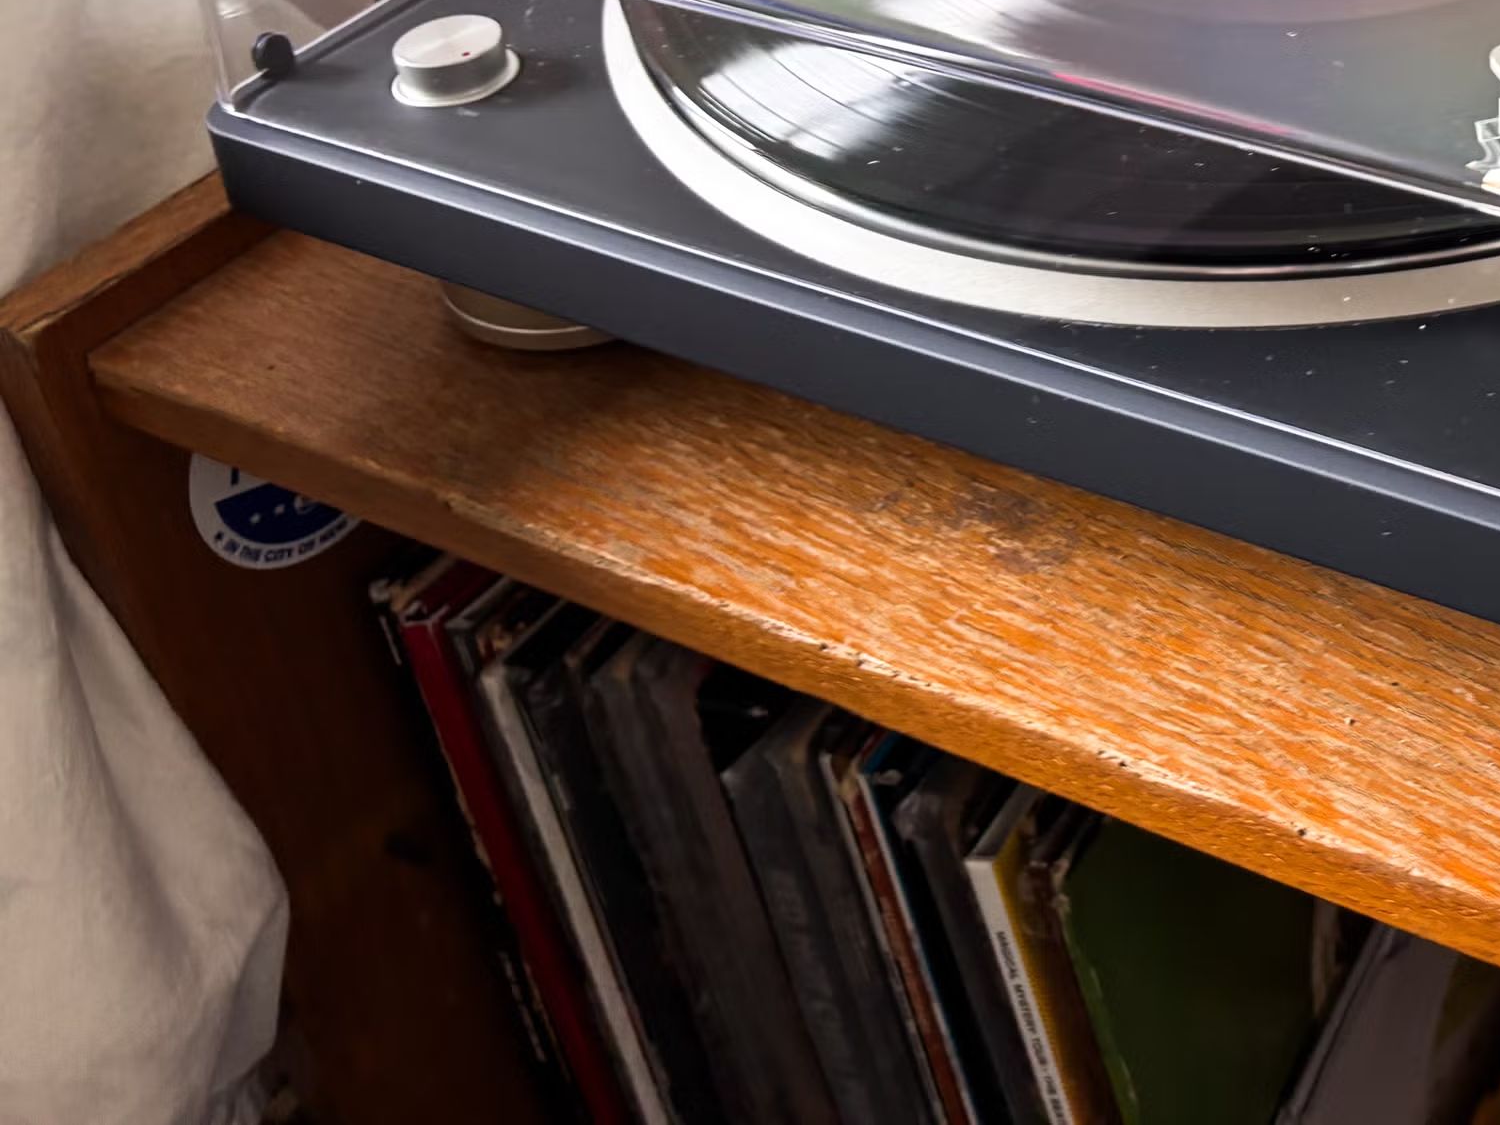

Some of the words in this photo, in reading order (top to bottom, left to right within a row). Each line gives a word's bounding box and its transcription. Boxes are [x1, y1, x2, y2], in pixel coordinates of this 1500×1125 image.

[996, 930, 1020, 980] MAGICAL
[1013, 983, 1038, 1035] MYSTERY
[1031, 1038, 1048, 1067] TOUR
